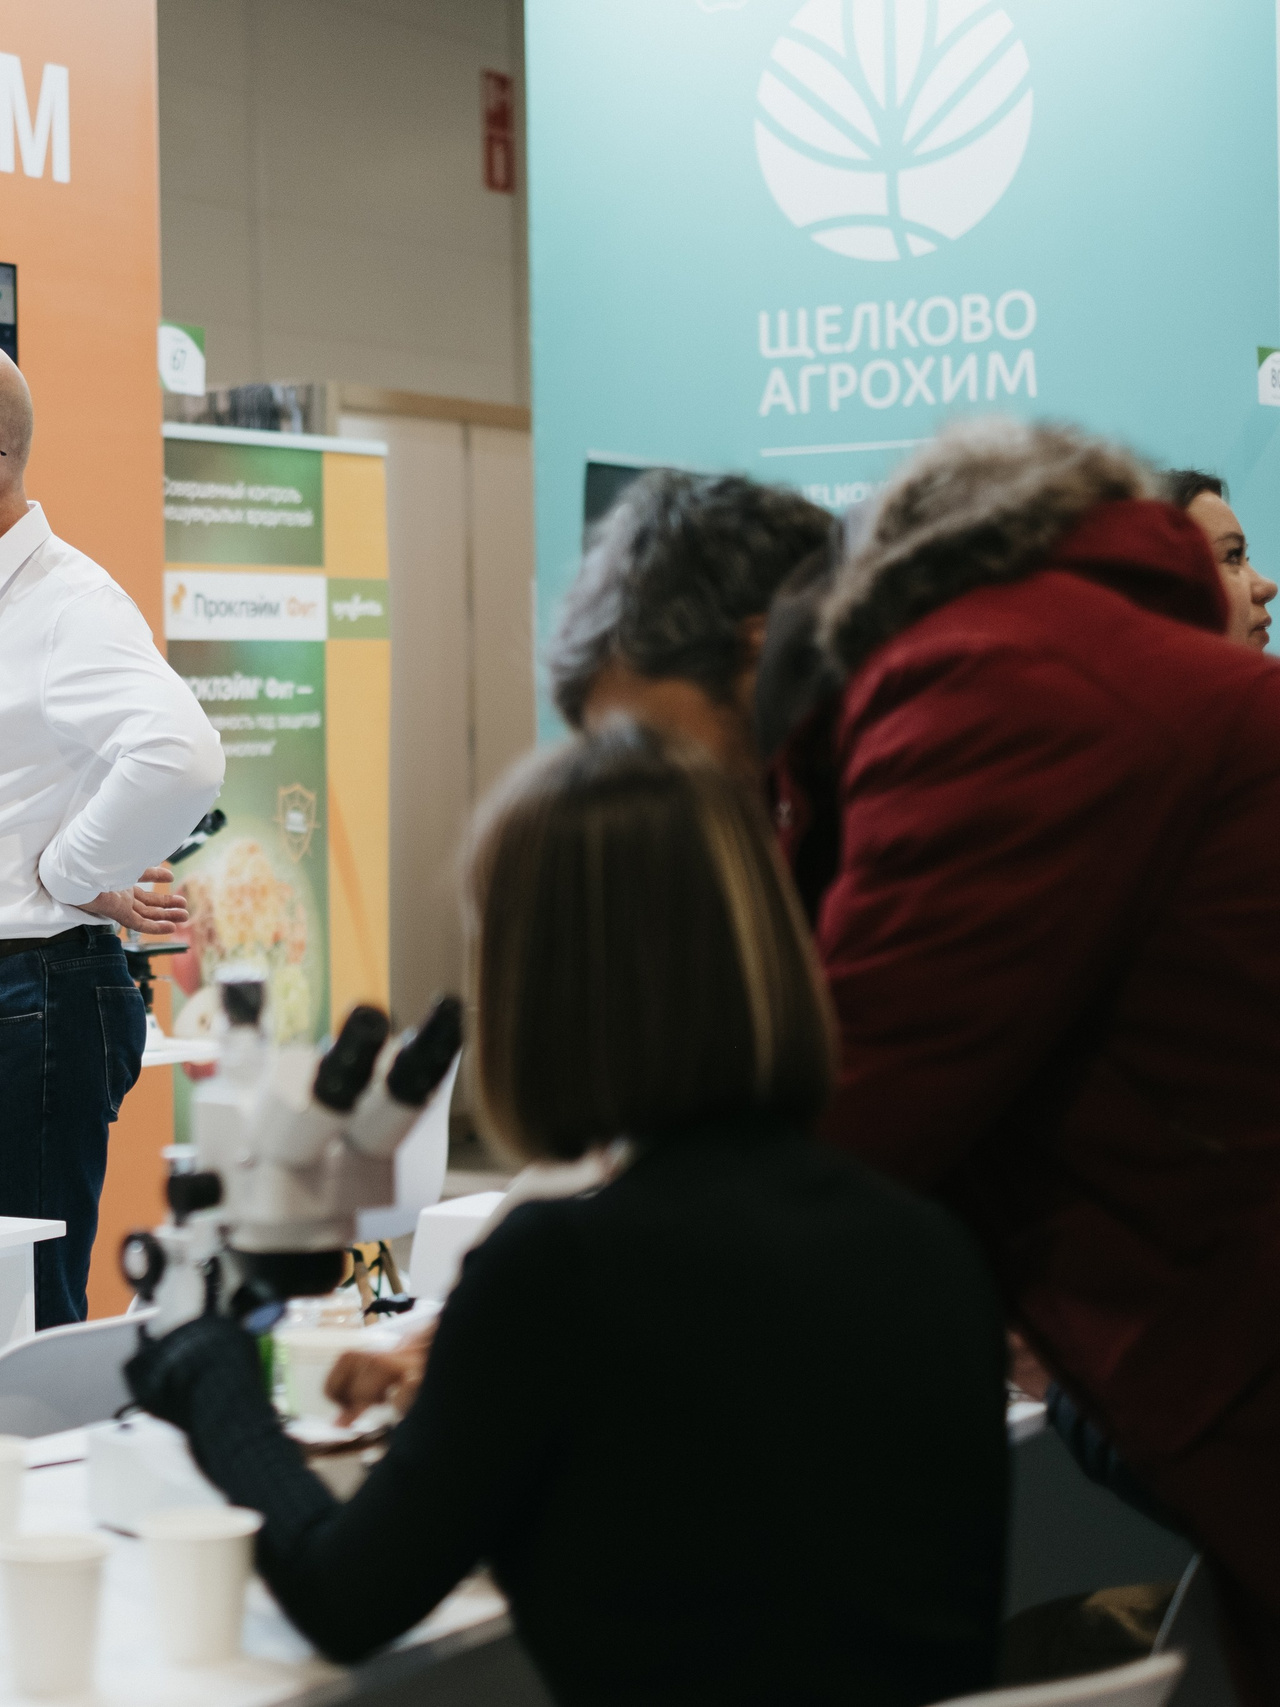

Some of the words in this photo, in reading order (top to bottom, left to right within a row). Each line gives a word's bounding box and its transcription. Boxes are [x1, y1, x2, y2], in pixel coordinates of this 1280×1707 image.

[758, 289, 1039, 360] ЩЕЛКОВО
[759, 348, 1039, 417] АГРОХИМ
[1271, 367, 1280, 389] 8
[193, 593, 281, 622] Проклэйм
